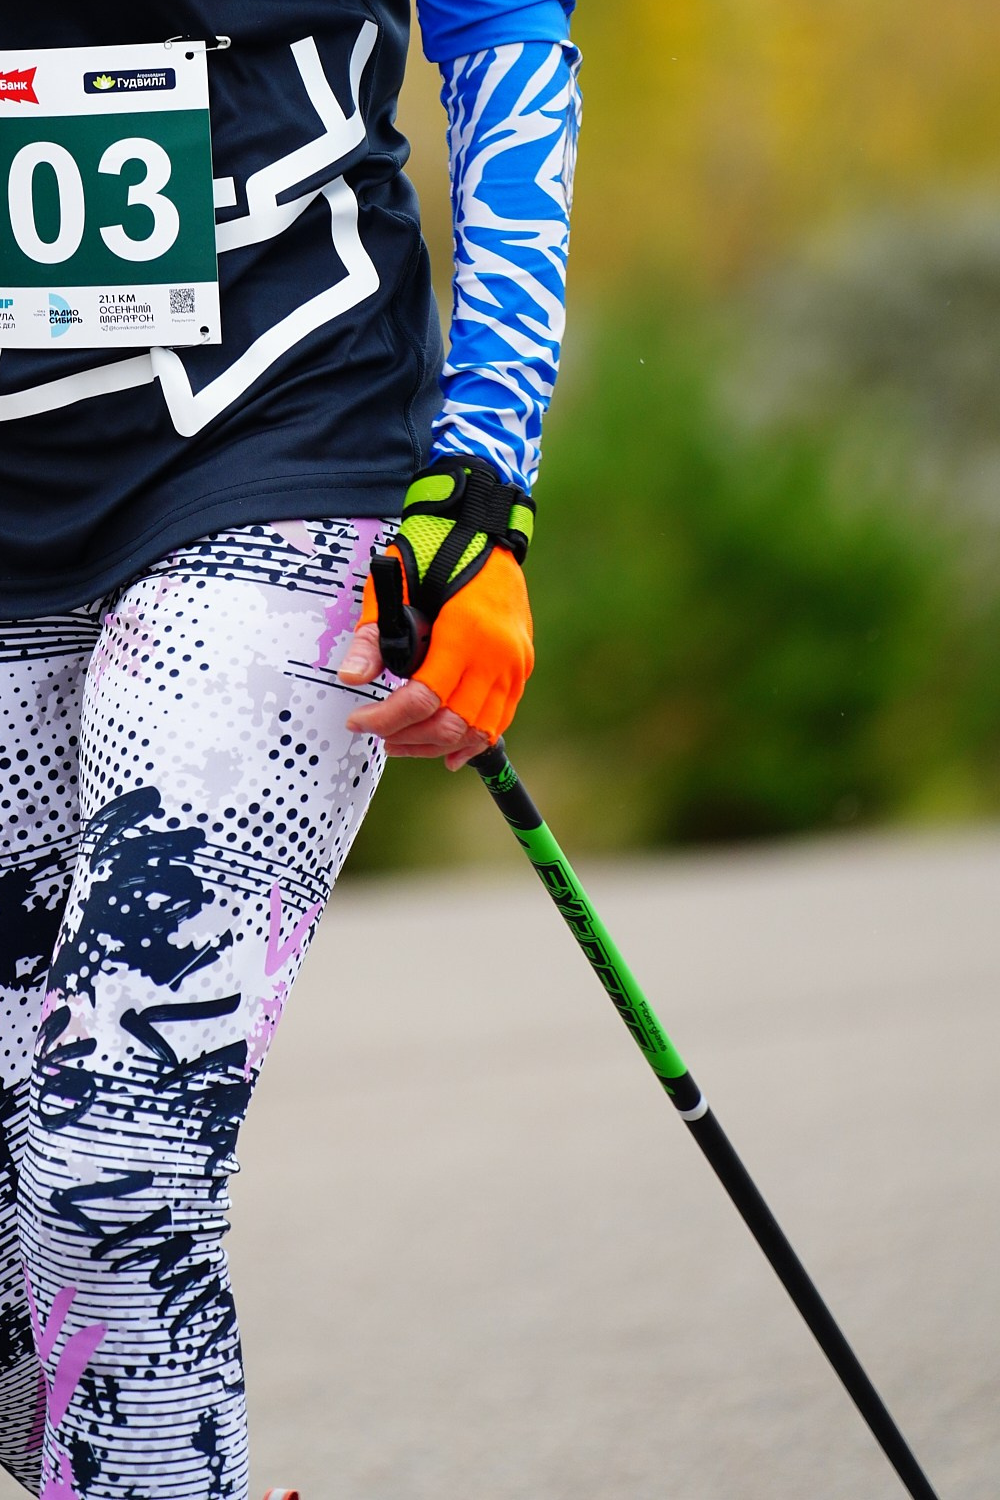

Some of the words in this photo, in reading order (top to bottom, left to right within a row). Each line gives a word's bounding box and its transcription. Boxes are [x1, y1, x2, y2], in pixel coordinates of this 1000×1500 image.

[0, 79, 28, 91] Банк
[98, 294, 116, 304] 21.1
[49, 309, 79, 317] РАДИО
[99, 303, 152, 314] ОСЕННИЙ
[49, 316, 83, 324] СИБИРЬ
[99, 314, 155, 324] МАРАФОН
[638, 1000, 669, 1053] Fiberglass
